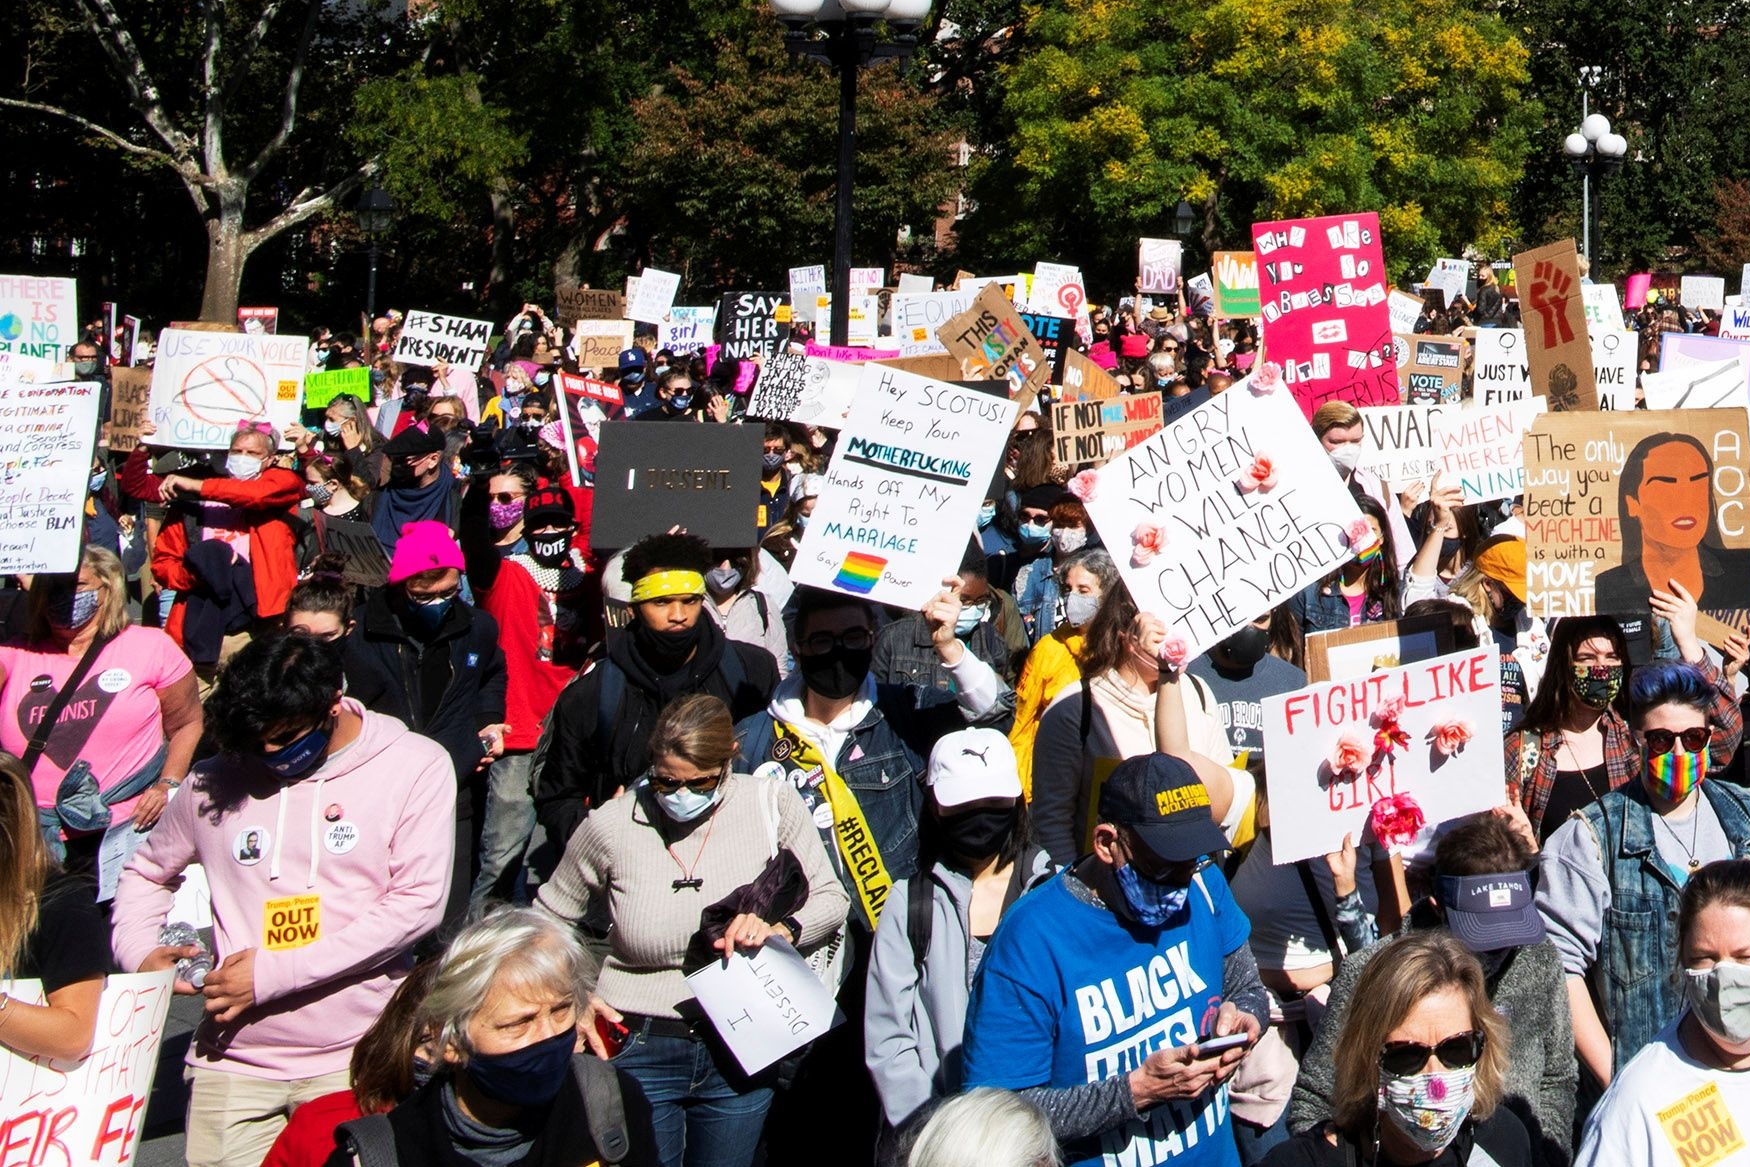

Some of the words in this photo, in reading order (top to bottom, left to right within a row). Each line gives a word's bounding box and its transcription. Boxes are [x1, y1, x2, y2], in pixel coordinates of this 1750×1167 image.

[867, 270, 882, 283] NOT
[1142, 265, 1175, 290] DAD
[0, 279, 64, 299] THERE
[560, 292, 617, 306] WOMEN
[32, 302, 56, 322] IS
[736, 294, 782, 317] SAY
[32, 322, 58, 342] NO
[409, 315, 488, 343] #SHAM
[670, 322, 697, 340] girl
[735, 318, 778, 338] HER
[956, 310, 998, 349] THIS
[164, 337, 211, 357] USE
[218, 337, 256, 358] YOUR
[261, 342, 303, 361] VOICE
[399, 336, 483, 365] PRESIDENT
[583, 338, 622, 361] Peace
[725, 338, 788, 358] NAME!
[765, 360, 811, 373] BELONG
[1067, 366, 1083, 387] NO
[1477, 364, 1515, 382] JUST
[1411, 375, 1443, 389] VOTE
[878, 371, 908, 400] Hey
[918, 385, 1007, 424] SCOTUS!
[155, 408, 171, 423] FOR
[880, 408, 915, 433] Keep
[926, 422, 961, 441] Your
[1055, 405, 1071, 431] IF
[1075, 400, 1105, 431] NOT
[1056, 435, 1071, 462] IF
[1127, 393, 1232, 489] ANGRY
[848, 436, 972, 479] MOTHERFUCKING
[1529, 433, 1576, 463] The
[1584, 431, 1625, 476] only
[628, 469, 635, 490] I
[1129, 426, 1256, 513] WOMEN
[1526, 466, 1570, 497] way
[1577, 469, 1610, 497] you
[827, 469, 865, 491] Hands
[877, 478, 905, 498] Off
[18, 506, 55, 517] Justice
[529, 493, 564, 510] RBG
[848, 497, 890, 522] Right
[901, 504, 918, 527] To
[1527, 493, 1576, 517] beat
[1588, 497, 1602, 515] a
[46, 516, 75, 530] BLM
[1525, 517, 1622, 544] MACHINE
[535, 540, 566, 557] VOTE
[823, 521, 918, 553] MARRIAGE
[1157, 489, 1320, 611] CHANGE
[1240, 522, 1350, 602] WORLD
[1535, 545, 1545, 559] is
[1555, 544, 1589, 559] with
[1594, 548, 1606, 559] a
[816, 550, 840, 570] Gay
[883, 571, 912, 589] Power
[1527, 561, 1596, 588] MOVE
[1526, 589, 1597, 617] MENT
[1284, 674, 1390, 735] FIGHT
[1402, 654, 1494, 708] LIKE
[328, 833, 355, 841] TRUMP
[1471, 883, 1495, 896] LAKE
[1498, 882, 1523, 892] TAHOE
[267, 896, 320, 909] Trump/Pence
[272, 907, 314, 927] OUT
[267, 923, 319, 945] NOW
[727, 1009, 754, 1032] I
[747, 959, 810, 1036] DISSENT
[1075, 940, 1209, 1046] BLACK
[1671, 1100, 1722, 1142] OUT
[1675, 1119, 1738, 1167] NOW
